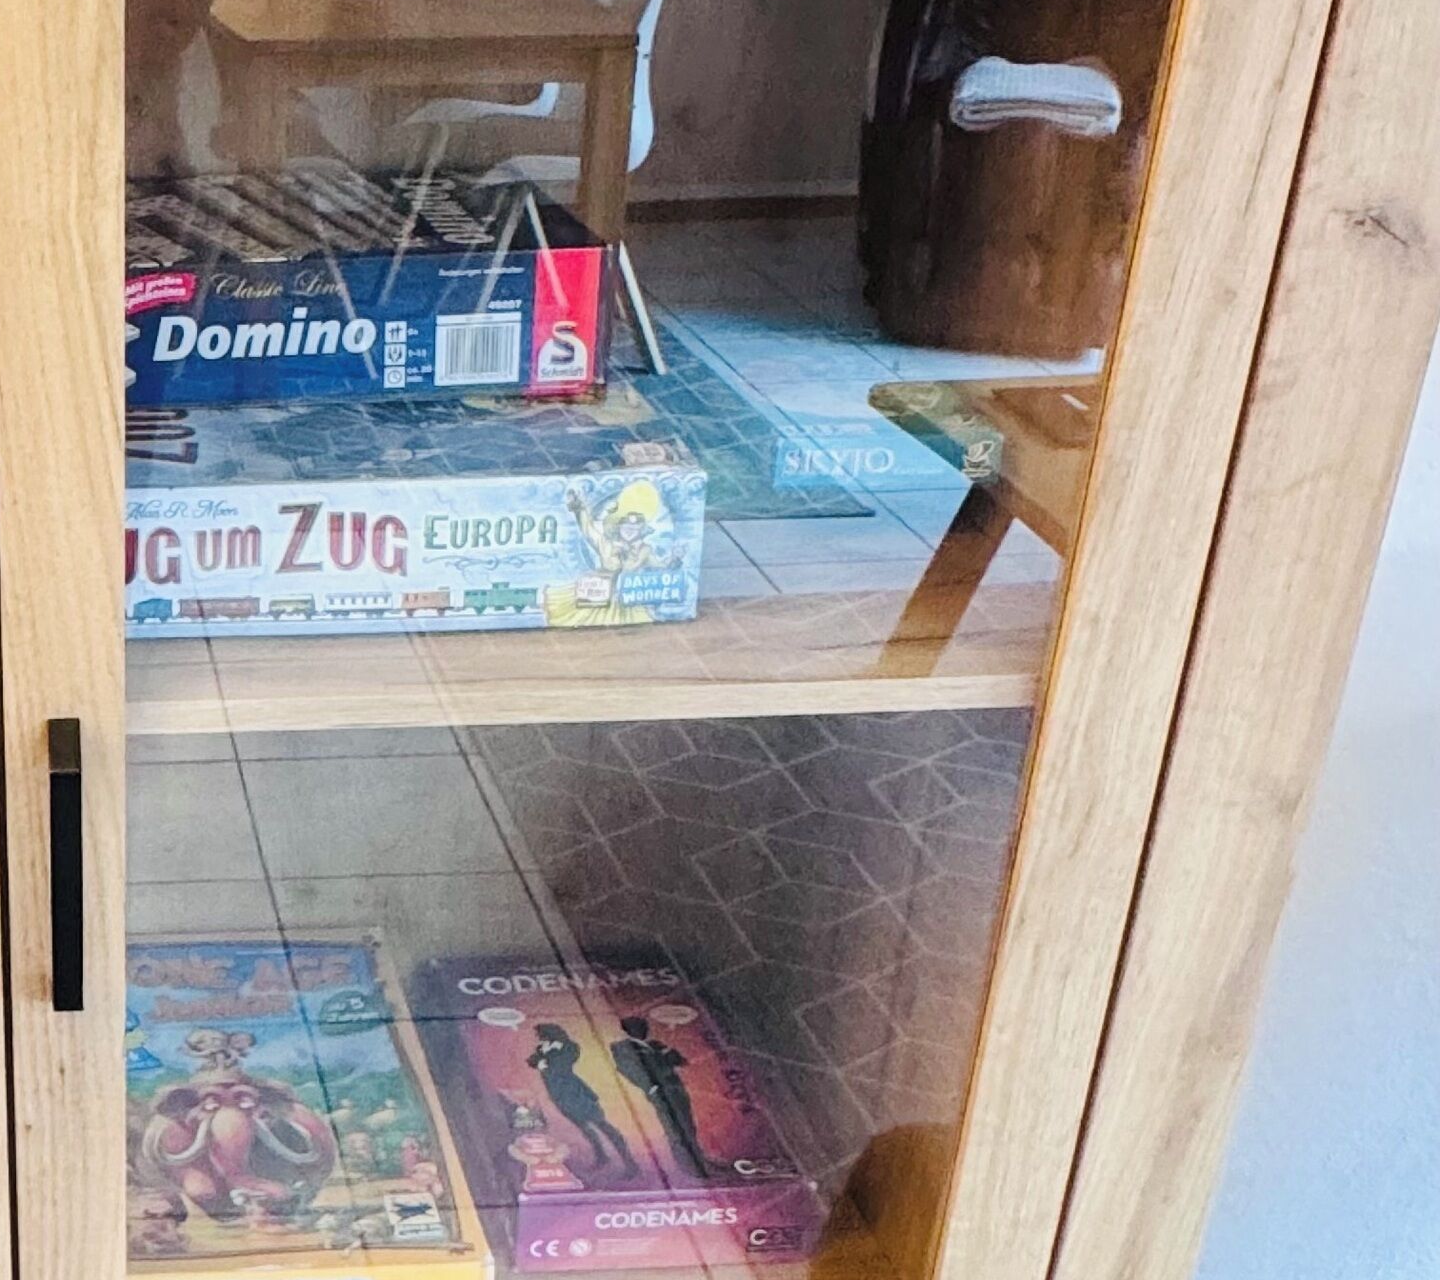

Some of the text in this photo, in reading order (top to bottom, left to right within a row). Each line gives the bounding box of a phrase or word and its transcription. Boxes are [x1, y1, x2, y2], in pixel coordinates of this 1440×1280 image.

[152, 306, 377, 362] Domino
[784, 447, 896, 478] SKYJO
[423, 513, 559, 550] EUROPA
[458, 968, 682, 996] CODENAMES
[594, 1207, 739, 1230] CODENAMES
